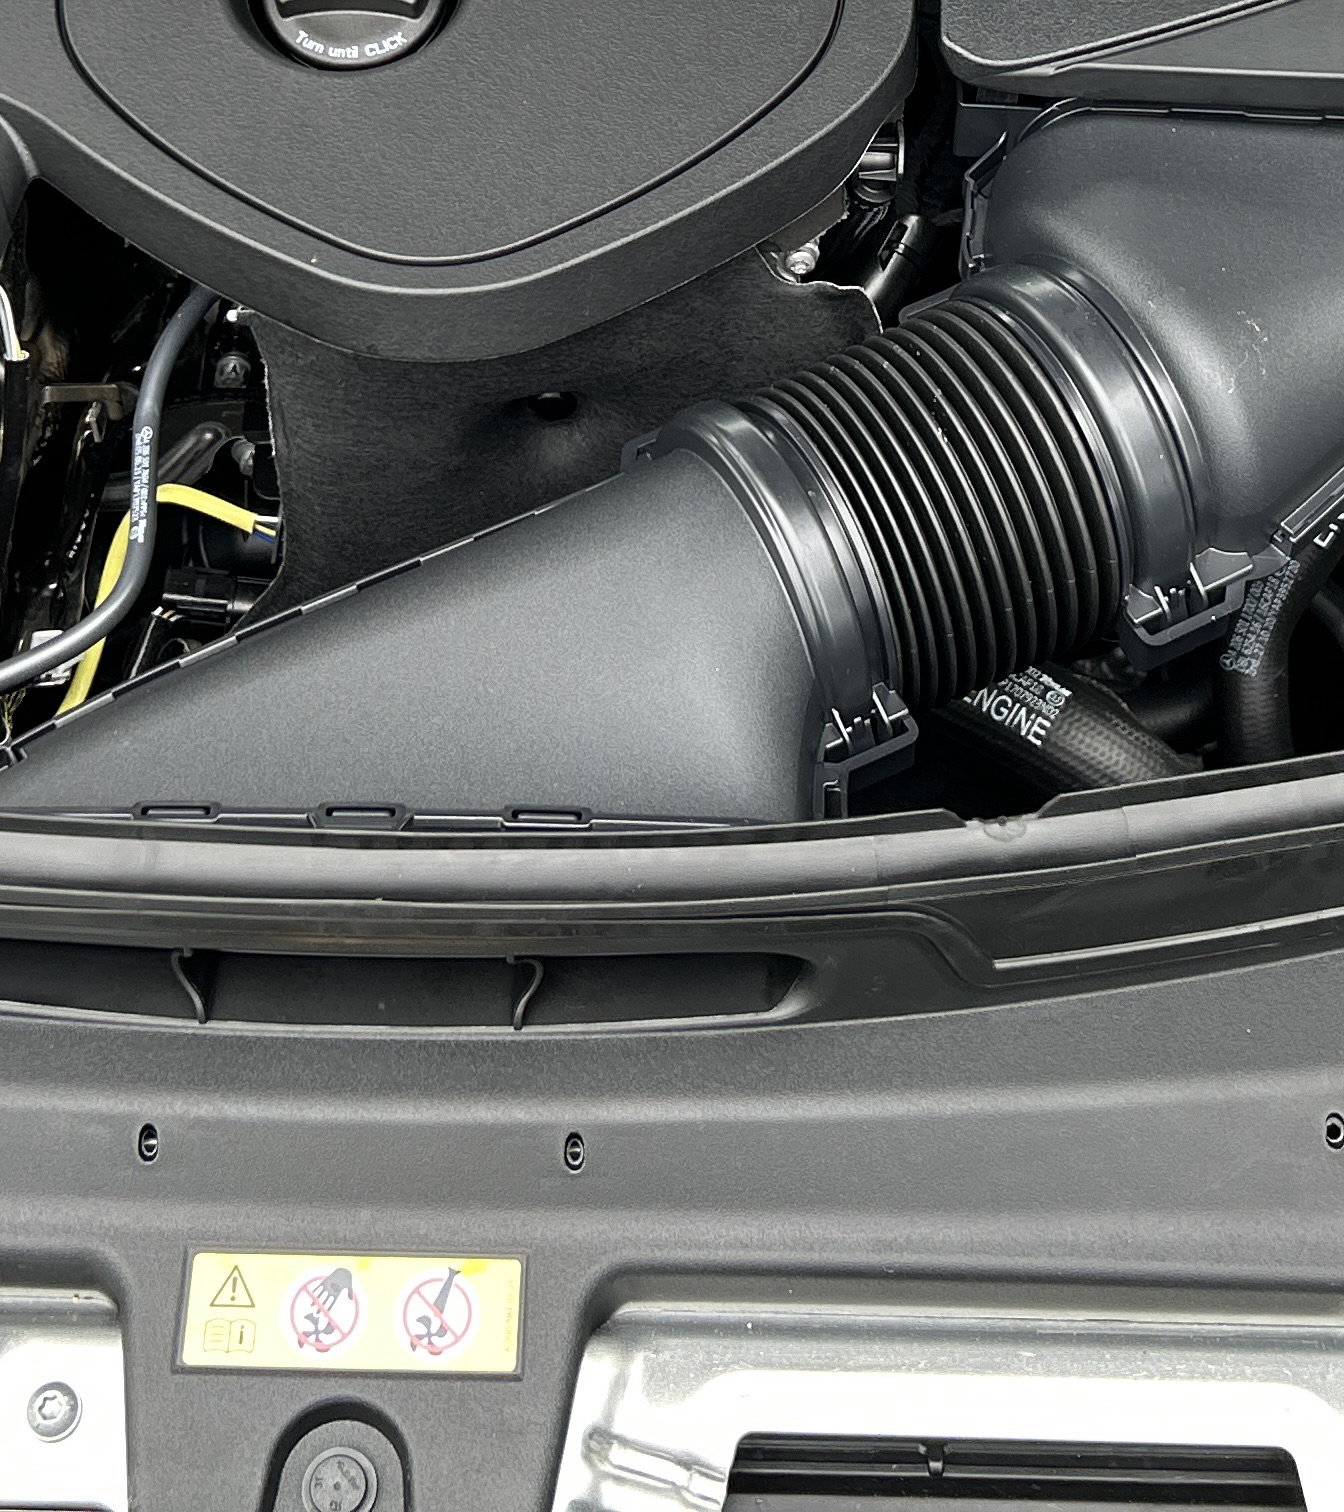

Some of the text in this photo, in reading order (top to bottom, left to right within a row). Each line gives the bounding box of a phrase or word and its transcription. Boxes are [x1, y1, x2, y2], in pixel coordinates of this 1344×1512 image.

[295, 29, 408, 58] Turn until CLICK
[962, 687, 1052, 748] NGINE
